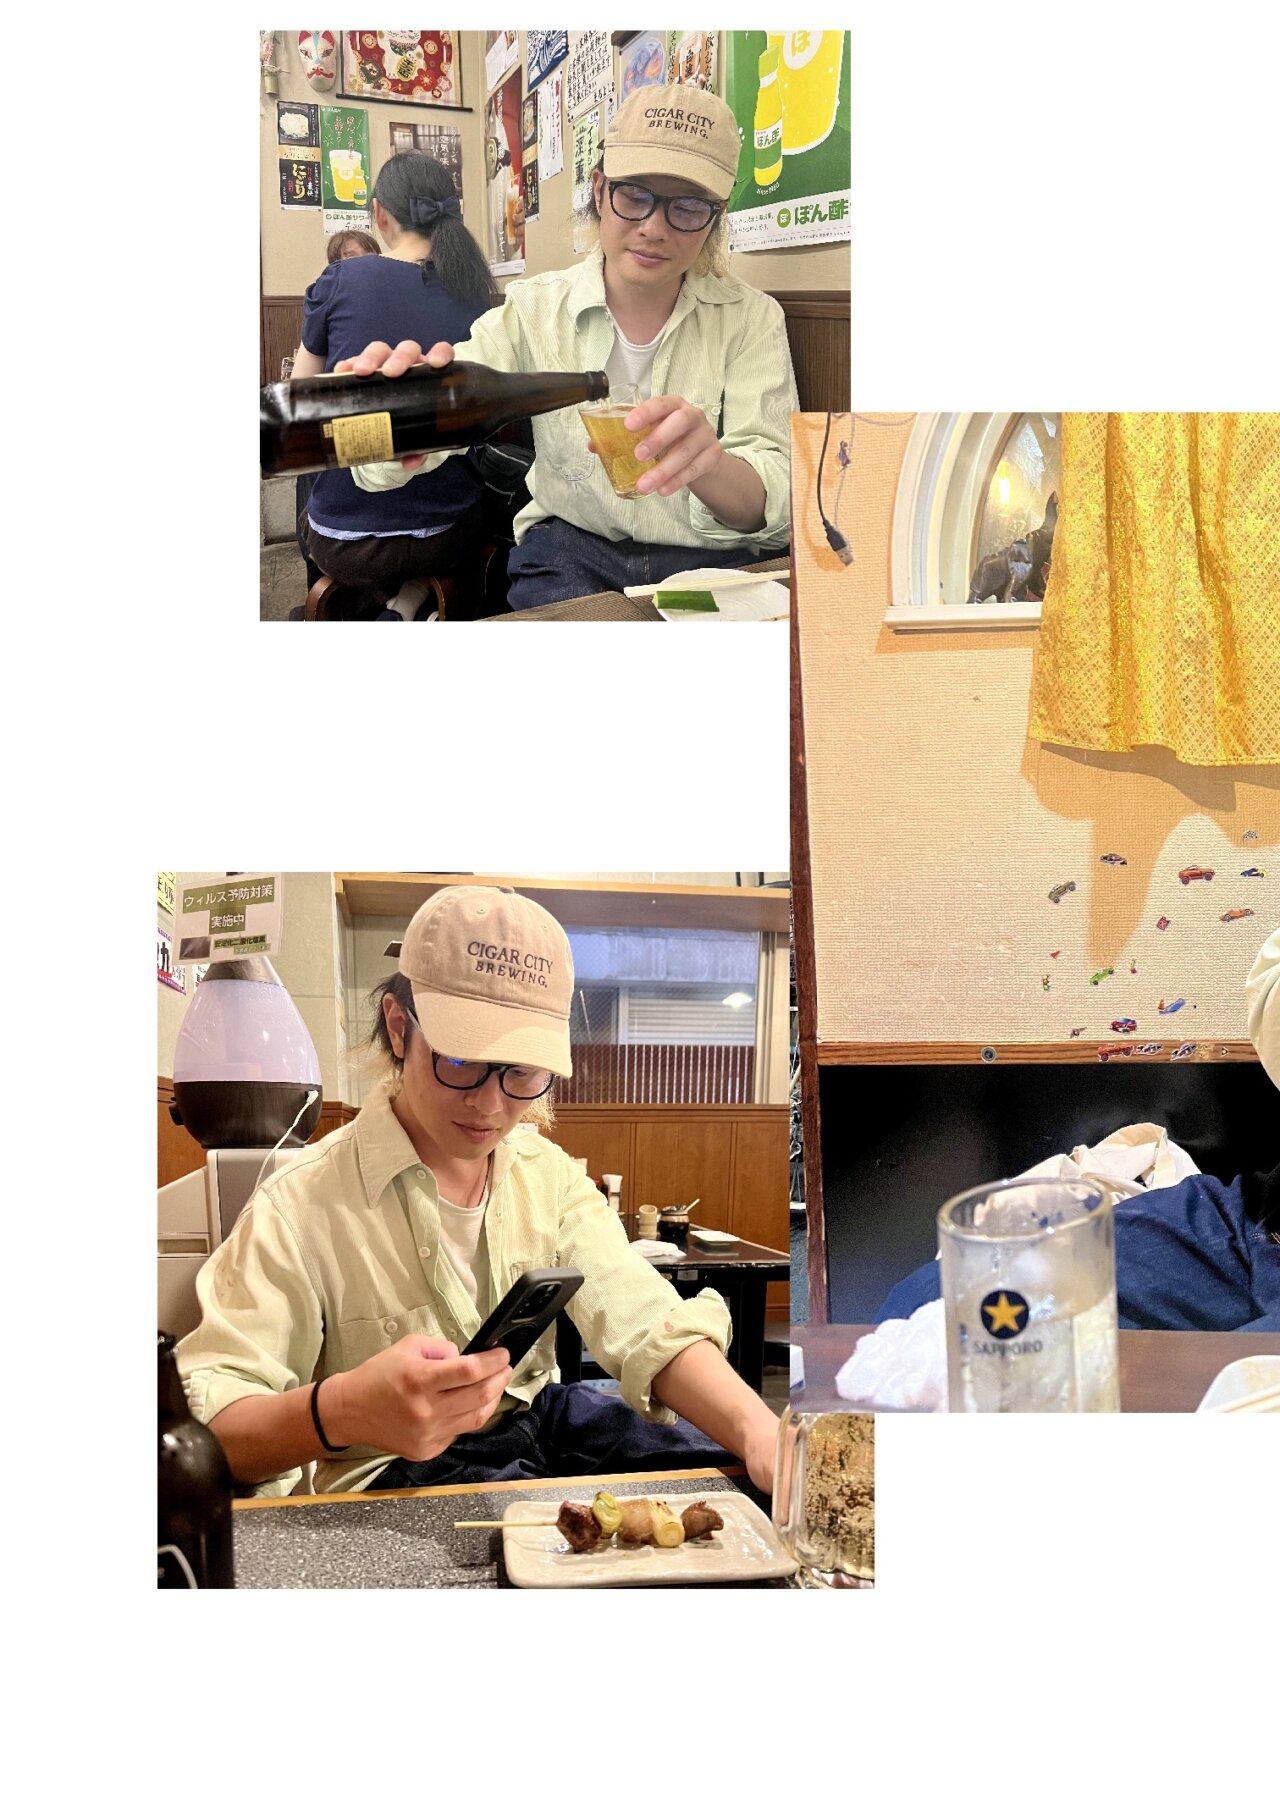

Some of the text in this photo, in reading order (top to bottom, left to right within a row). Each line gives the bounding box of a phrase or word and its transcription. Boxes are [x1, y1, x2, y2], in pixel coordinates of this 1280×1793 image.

[644, 107, 715, 131] CIGAR CITY
[648, 119, 709, 140] BREWING.
[794, 199, 850, 226] ぽん酢
[184, 885, 273, 907] ウィルス予防対策
[211, 914, 245, 929] 実施中
[467, 941, 553, 974] CIGAR CITY
[475, 960, 548, 988] BREWING.
[973, 1340, 1043, 1358] SAPPORO
